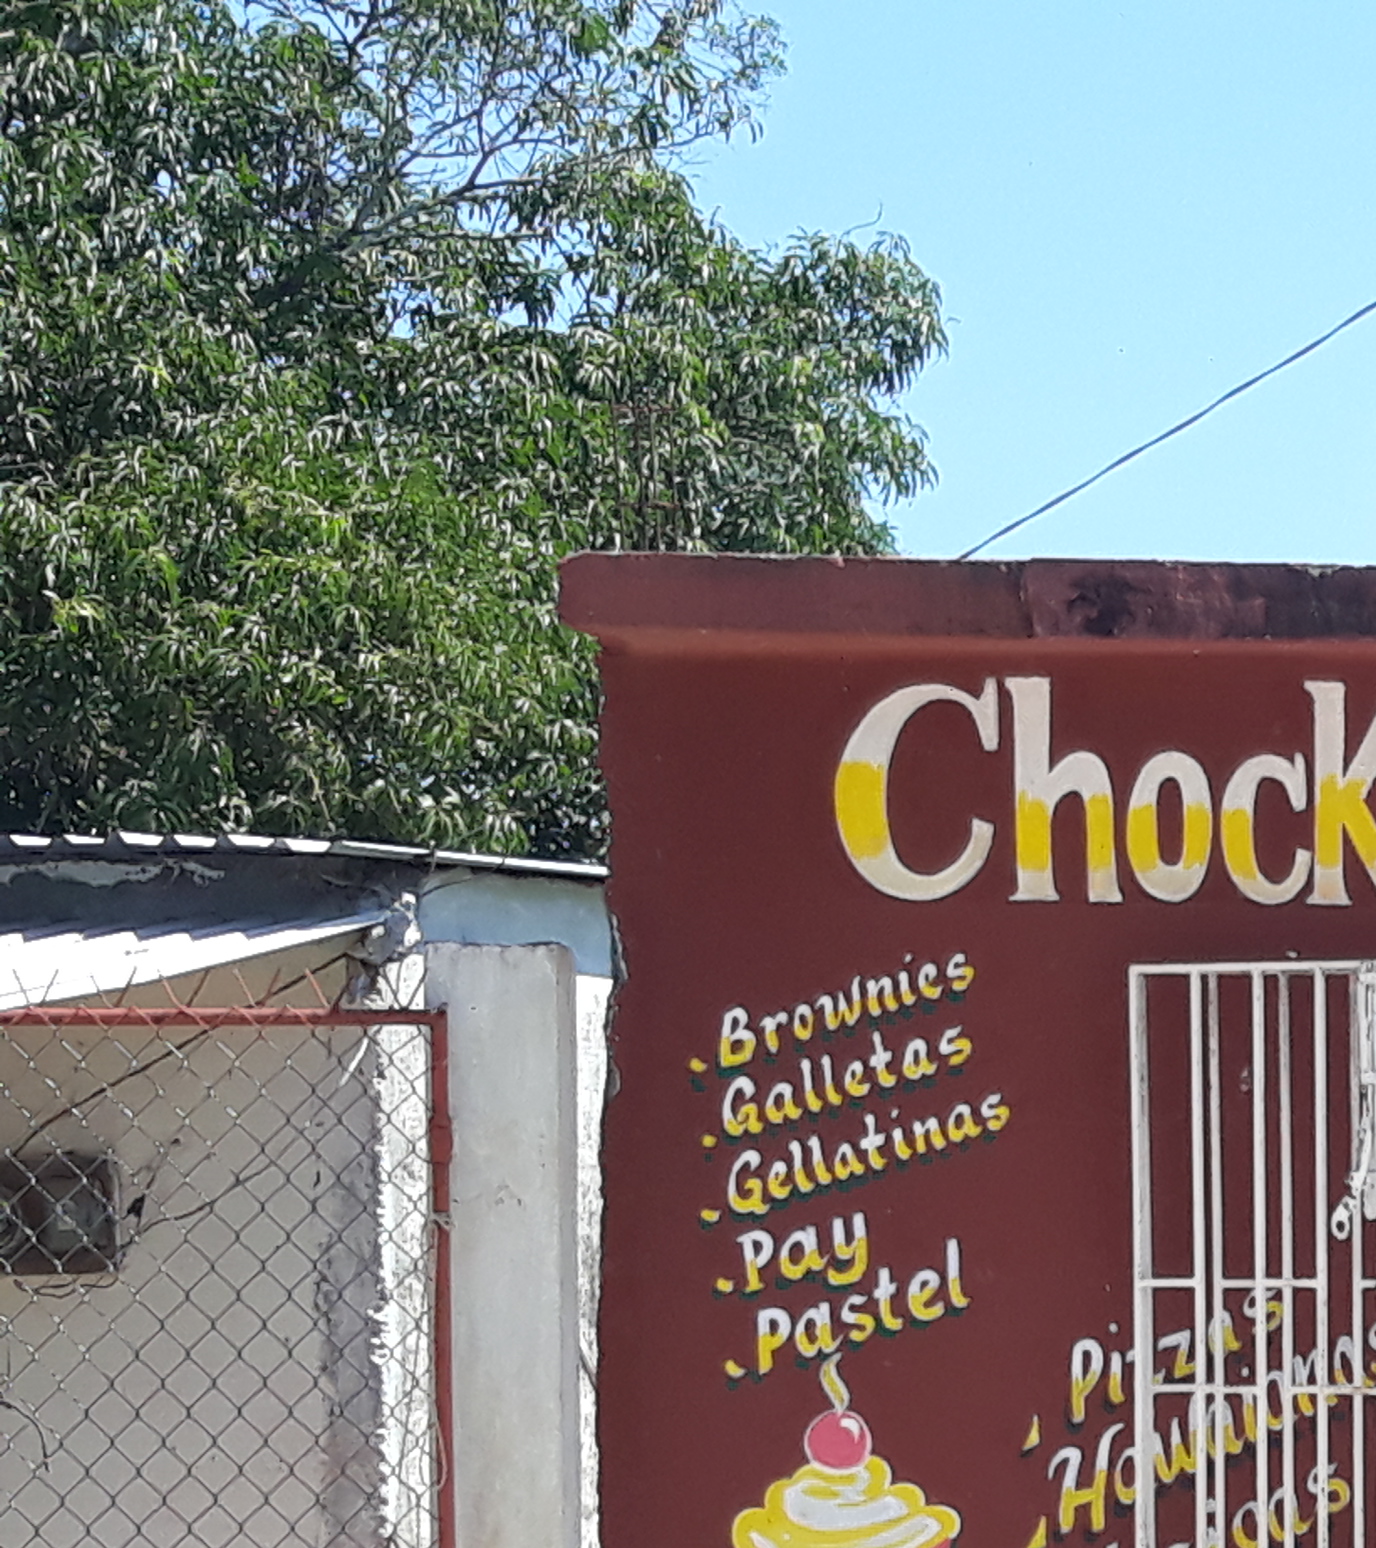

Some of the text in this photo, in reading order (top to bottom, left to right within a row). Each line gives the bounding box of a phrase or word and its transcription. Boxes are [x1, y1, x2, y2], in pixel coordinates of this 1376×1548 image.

[719, 952, 975, 1068] Brownies
[721, 1025, 973, 1138] Galletas
[726, 1093, 1011, 1215] Gellatinas
[1070, 1287, 1285, 1423] Pizas
